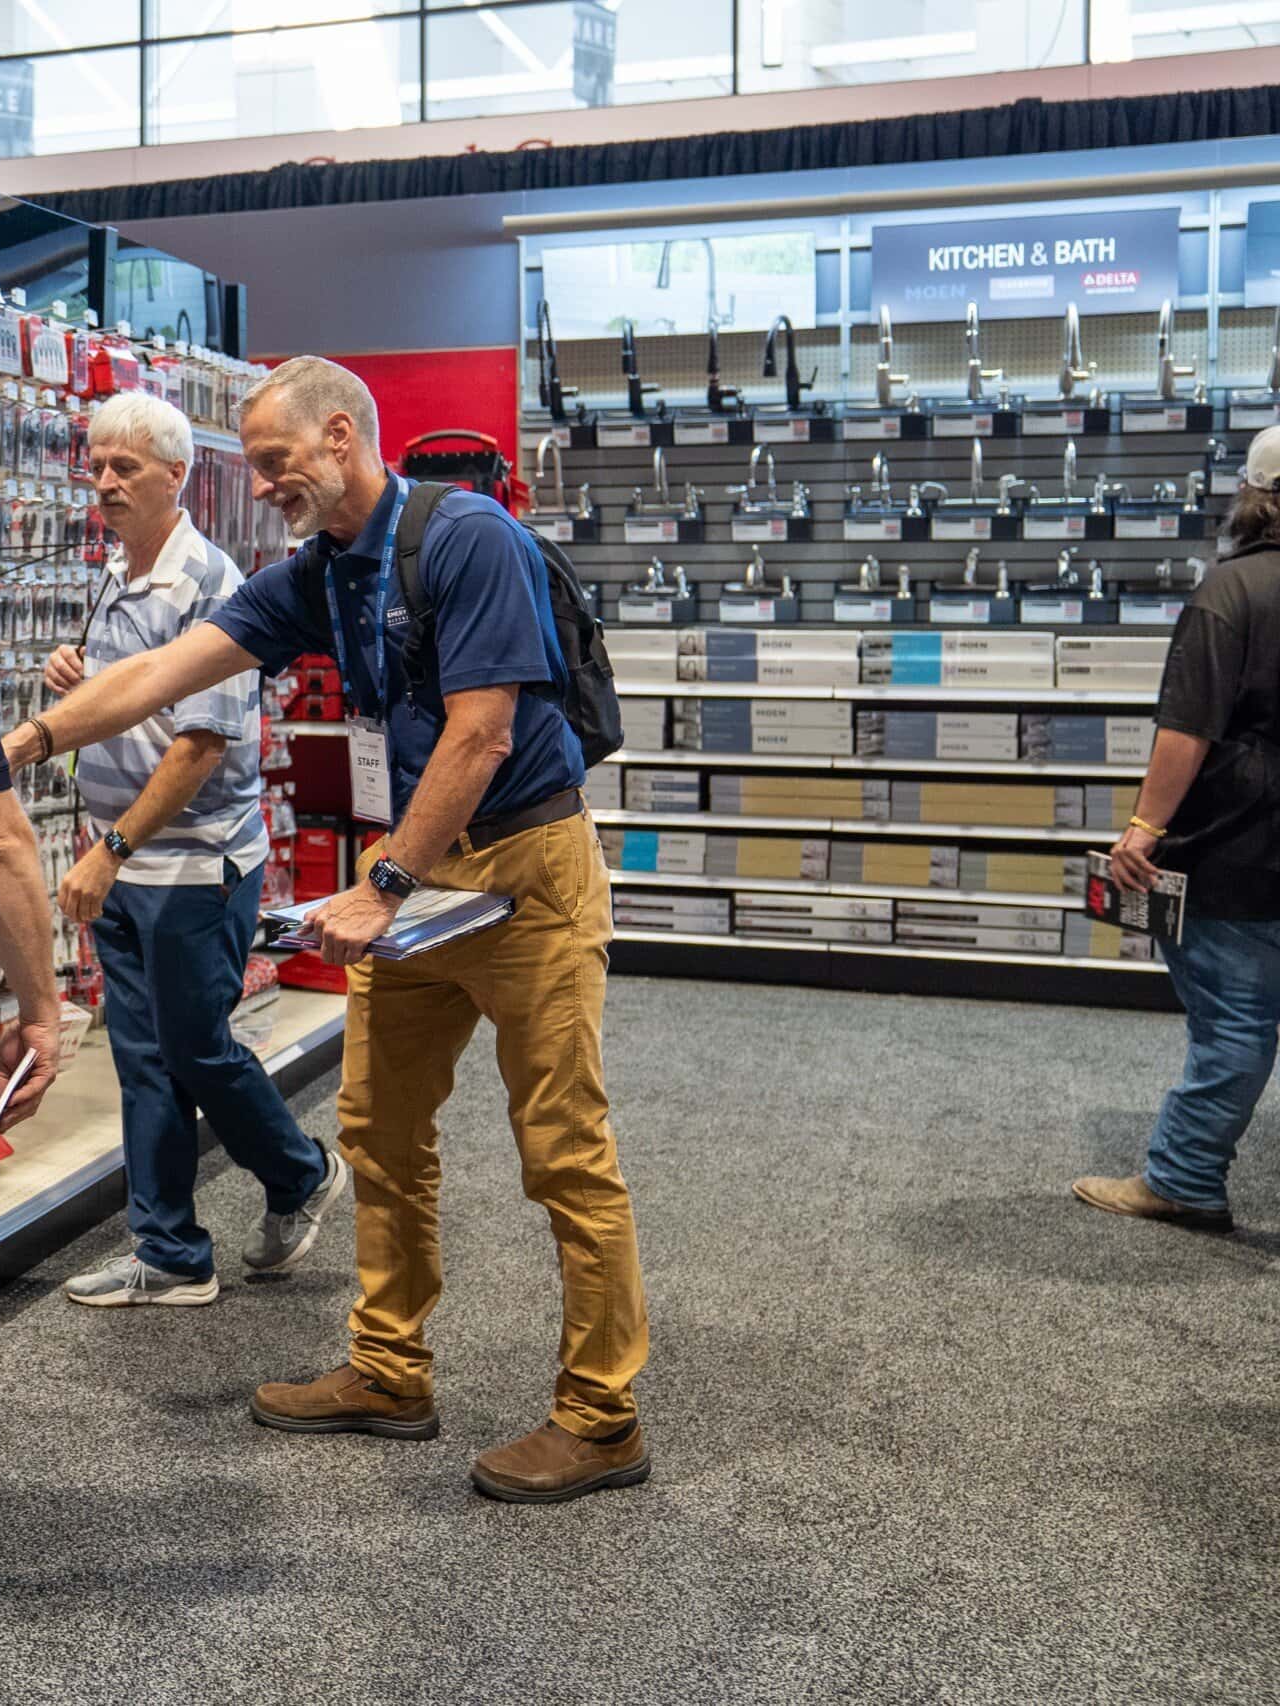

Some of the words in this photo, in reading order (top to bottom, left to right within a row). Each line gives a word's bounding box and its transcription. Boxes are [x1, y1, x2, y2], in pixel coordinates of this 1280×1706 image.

[928, 243, 1024, 271] KITCHEN
[1030, 242, 1048, 266] &
[1055, 238, 1116, 264] BATH
[1096, 272, 1137, 286] DELTA
[905, 283, 968, 300] MOEN
[761, 640, 792, 649] MOEN
[959, 641, 988, 649] MOEN
[762, 667, 794, 675] MOEN
[958, 666, 988, 674] MOEN
[756, 709, 787, 717] MOEN
[757, 735, 788, 744] MOEN
[357, 756, 380, 768] STAFF
